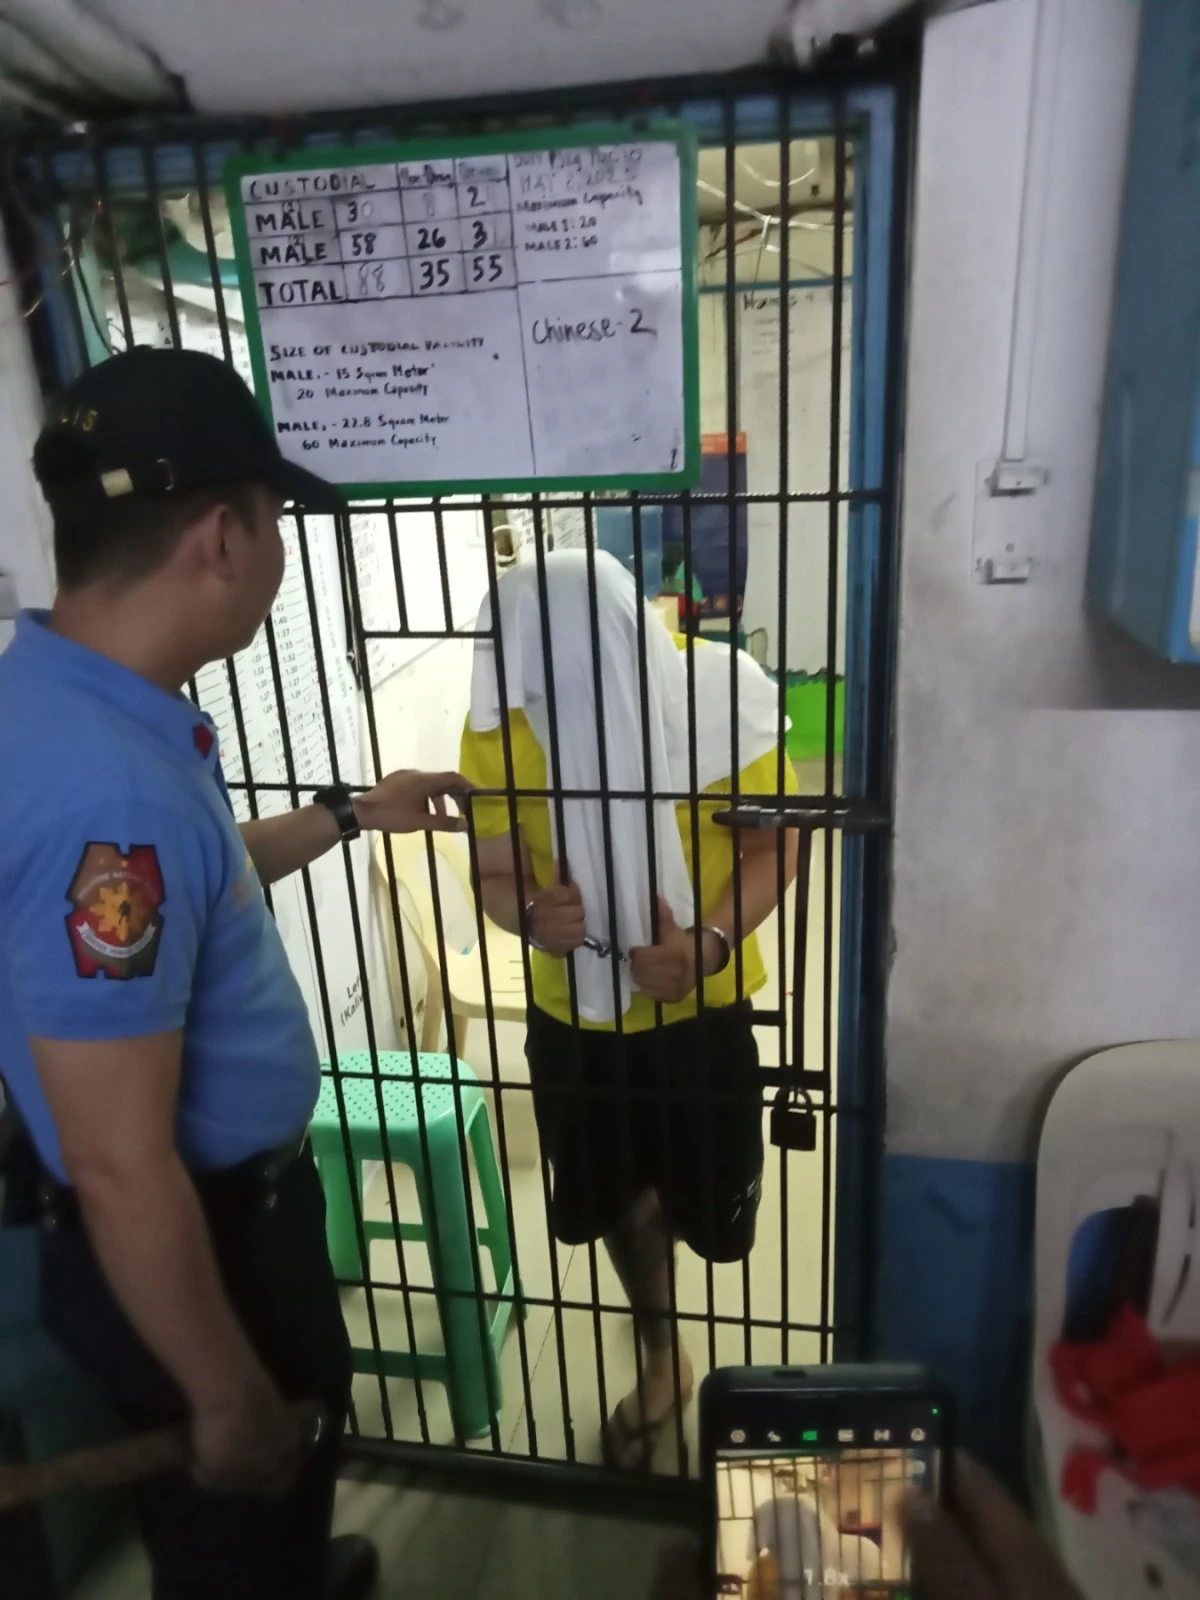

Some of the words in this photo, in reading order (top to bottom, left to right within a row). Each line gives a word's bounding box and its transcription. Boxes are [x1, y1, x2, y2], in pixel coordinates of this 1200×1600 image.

[256, 209, 325, 232] MALE
[260, 241, 328, 265] MALE
[351, 232, 376, 256] 58
[417, 227, 447, 250] 26
[258, 279, 344, 305] TOTAL
[420, 258, 450, 290] 35
[472, 254, 503, 283] 55
[270, 344, 306, 361] SIZE
[313, 344, 332, 356] OF
[336, 367, 350, 380] 15
[297, 388, 315, 400] 20
[302, 439, 320, 451] 60
